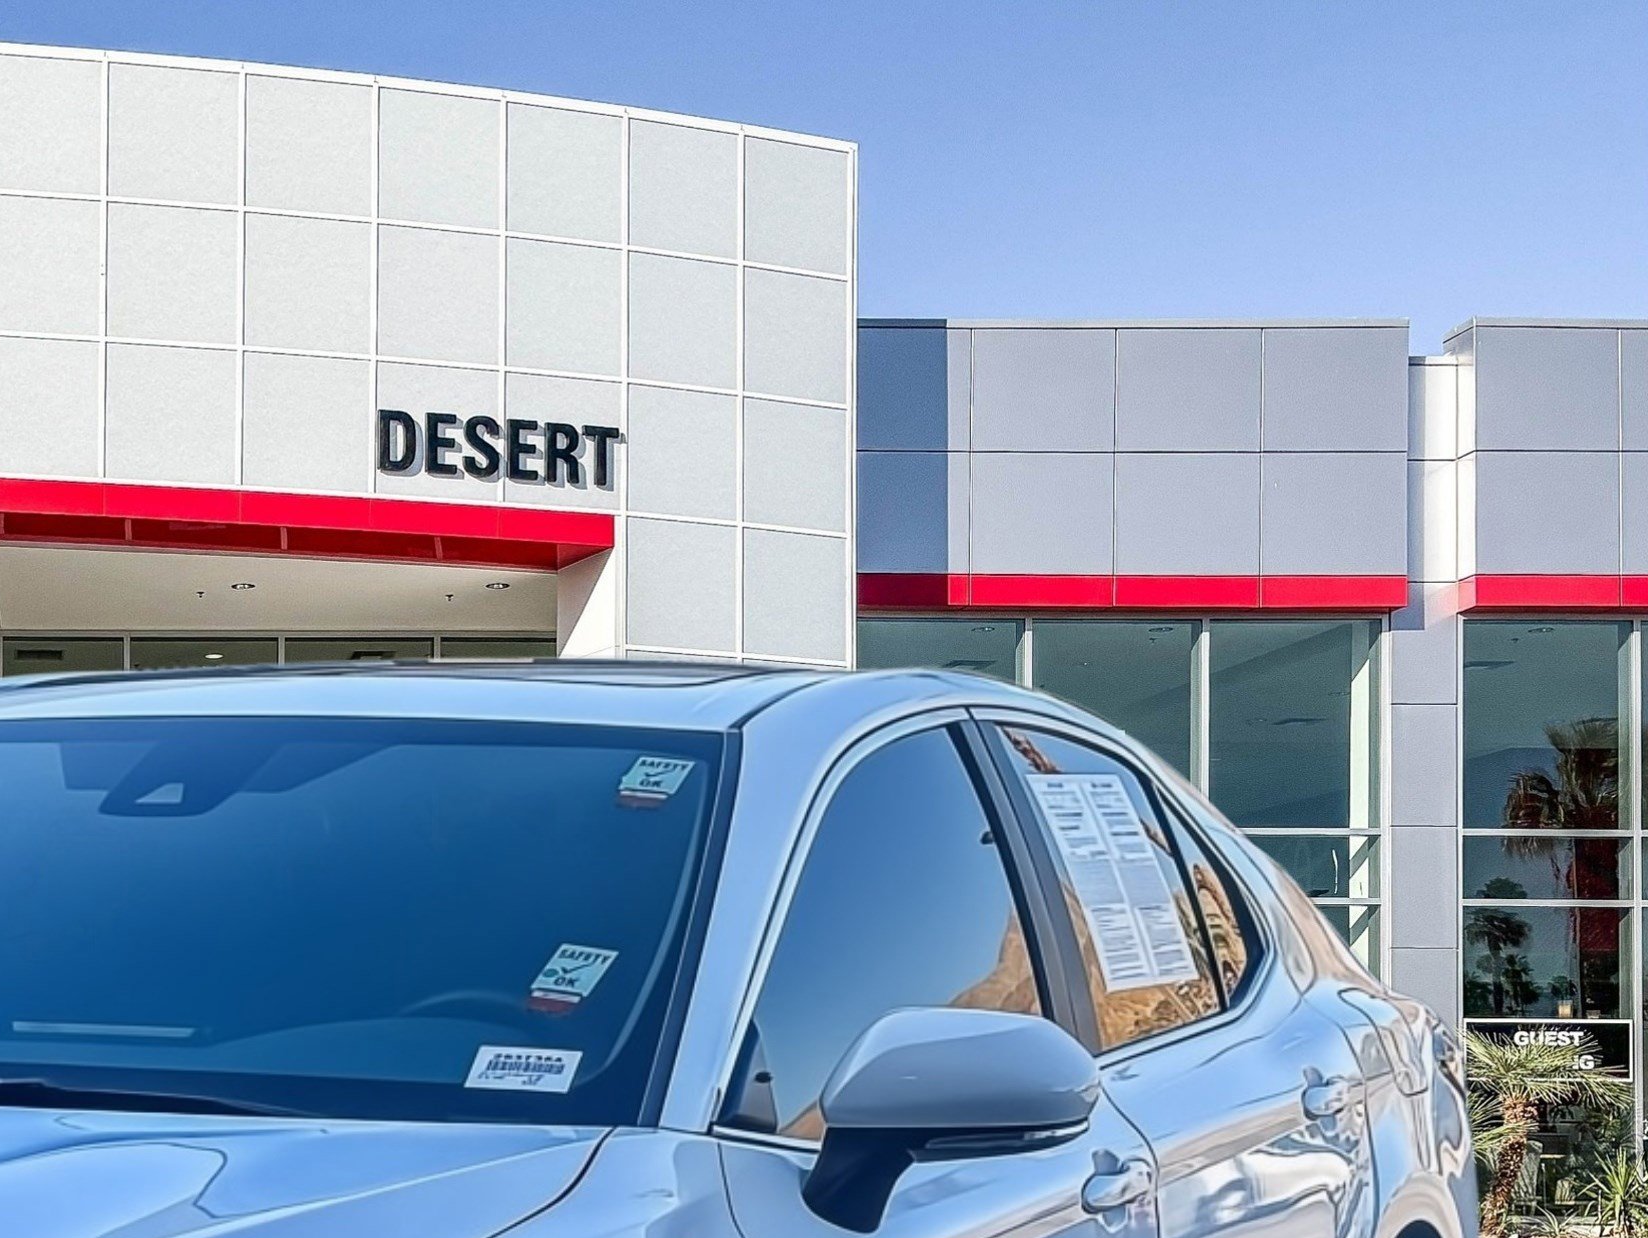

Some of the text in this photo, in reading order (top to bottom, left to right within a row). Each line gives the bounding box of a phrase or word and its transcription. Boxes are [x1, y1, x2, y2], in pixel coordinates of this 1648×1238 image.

[377, 409, 620, 488] DESERT
[558, 949, 612, 964] SAFETY
[554, 976, 579, 988] OK
[1513, 1031, 1584, 1046] GUEST
